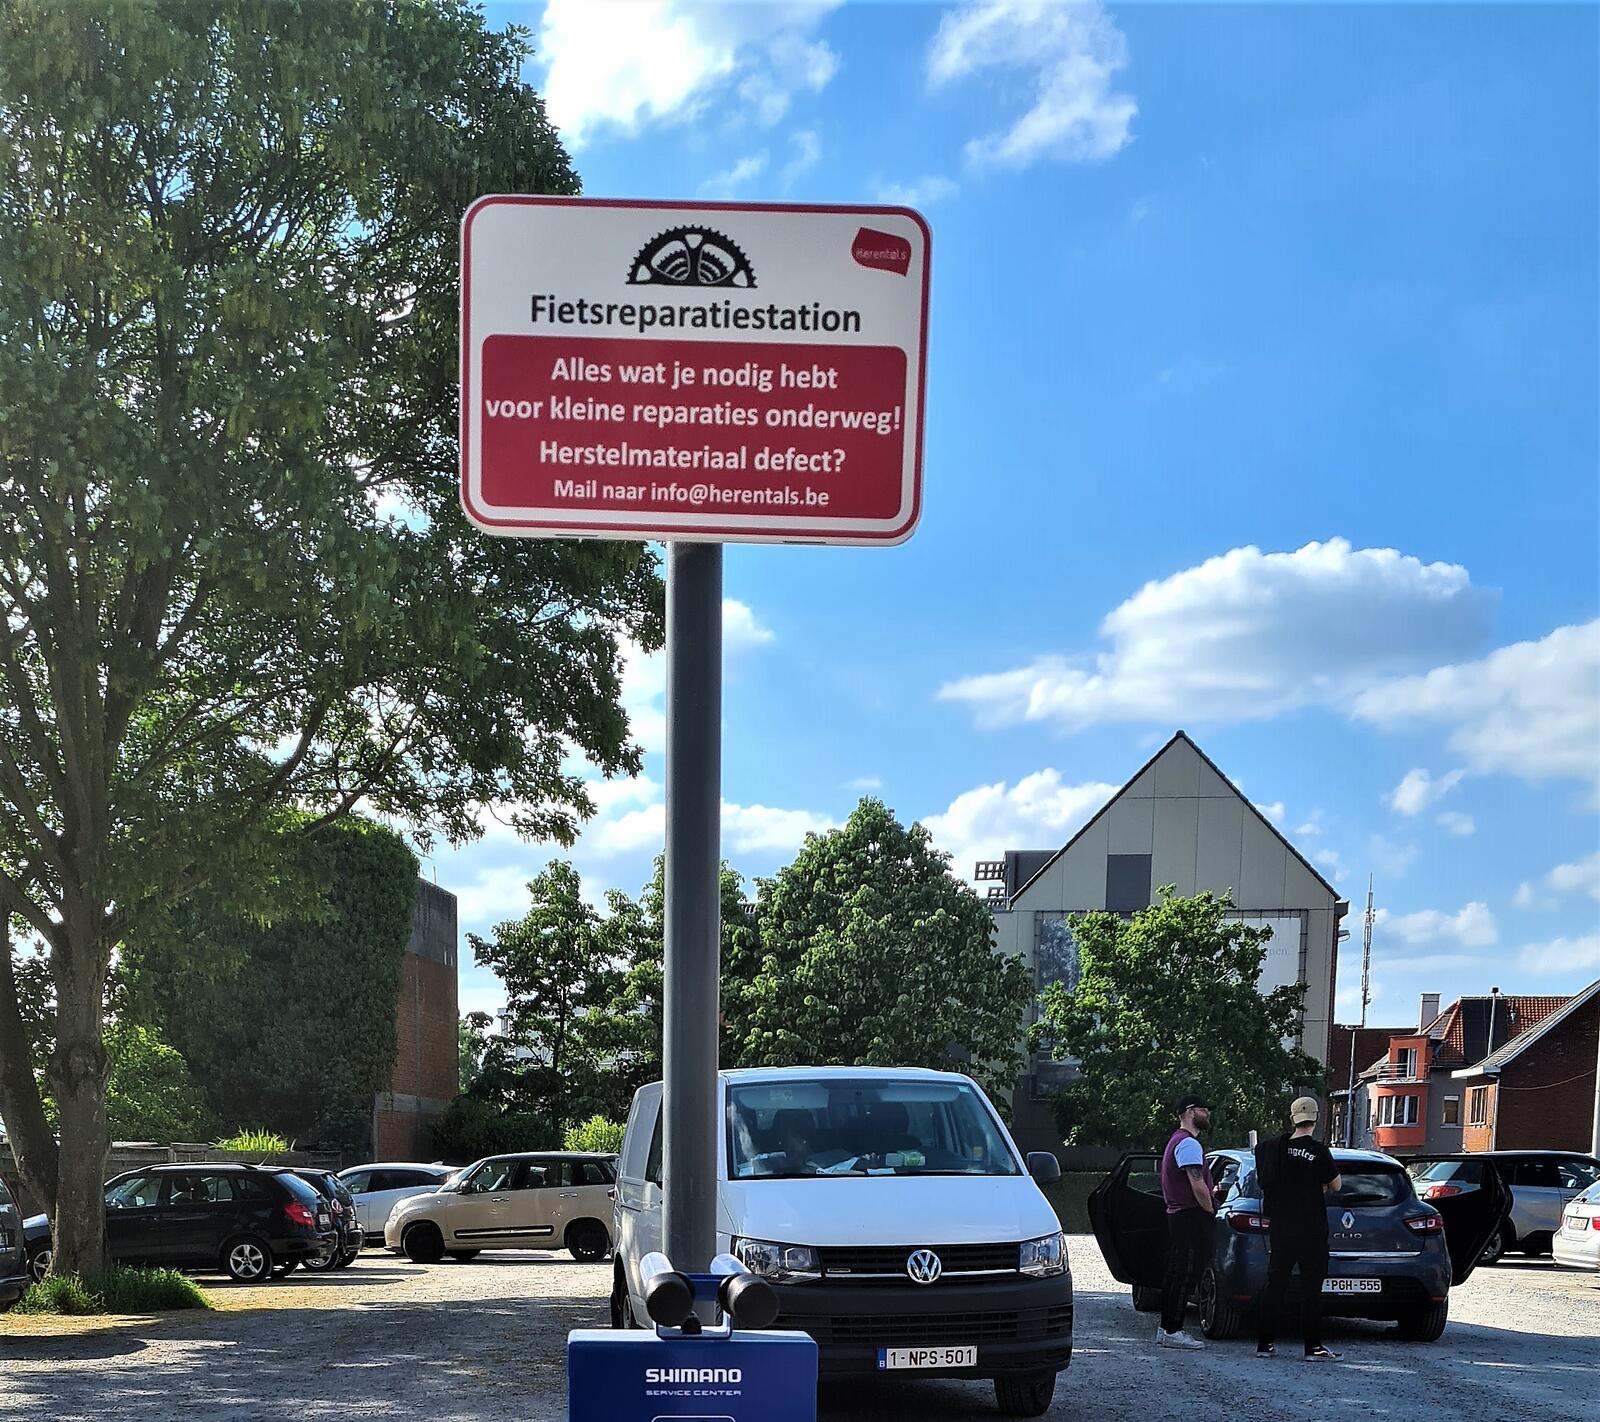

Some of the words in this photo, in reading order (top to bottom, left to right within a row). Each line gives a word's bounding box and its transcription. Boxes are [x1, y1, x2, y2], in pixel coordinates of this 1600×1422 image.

[531, 294, 861, 333] Fietsreparatiestation
[551, 357, 612, 382] Alles
[619, 362, 667, 385] wat
[671, 360, 696, 390] je
[703, 362, 774, 392] nodig
[780, 363, 838, 389] hebt
[485, 399, 543, 419] voor
[550, 395, 626, 423] kleine
[632, 401, 758, 428] reparaties
[765, 403, 901, 435] onderweg!
[539, 440, 747, 470] Herstelmateriaal
[754, 446, 846, 473] defect?
[554, 479, 597, 499] Mail
[602, 484, 647, 500] naar
[651, 482, 829, 506] info@herentals.be
[1287, 1147, 1316, 1161] ngeles
[1325, 1280, 1381, 1291] -PGH-555
[890, 1349, 973, 1367] 1-NPS-501
[645, 1368, 742, 1383] SHIMANO
